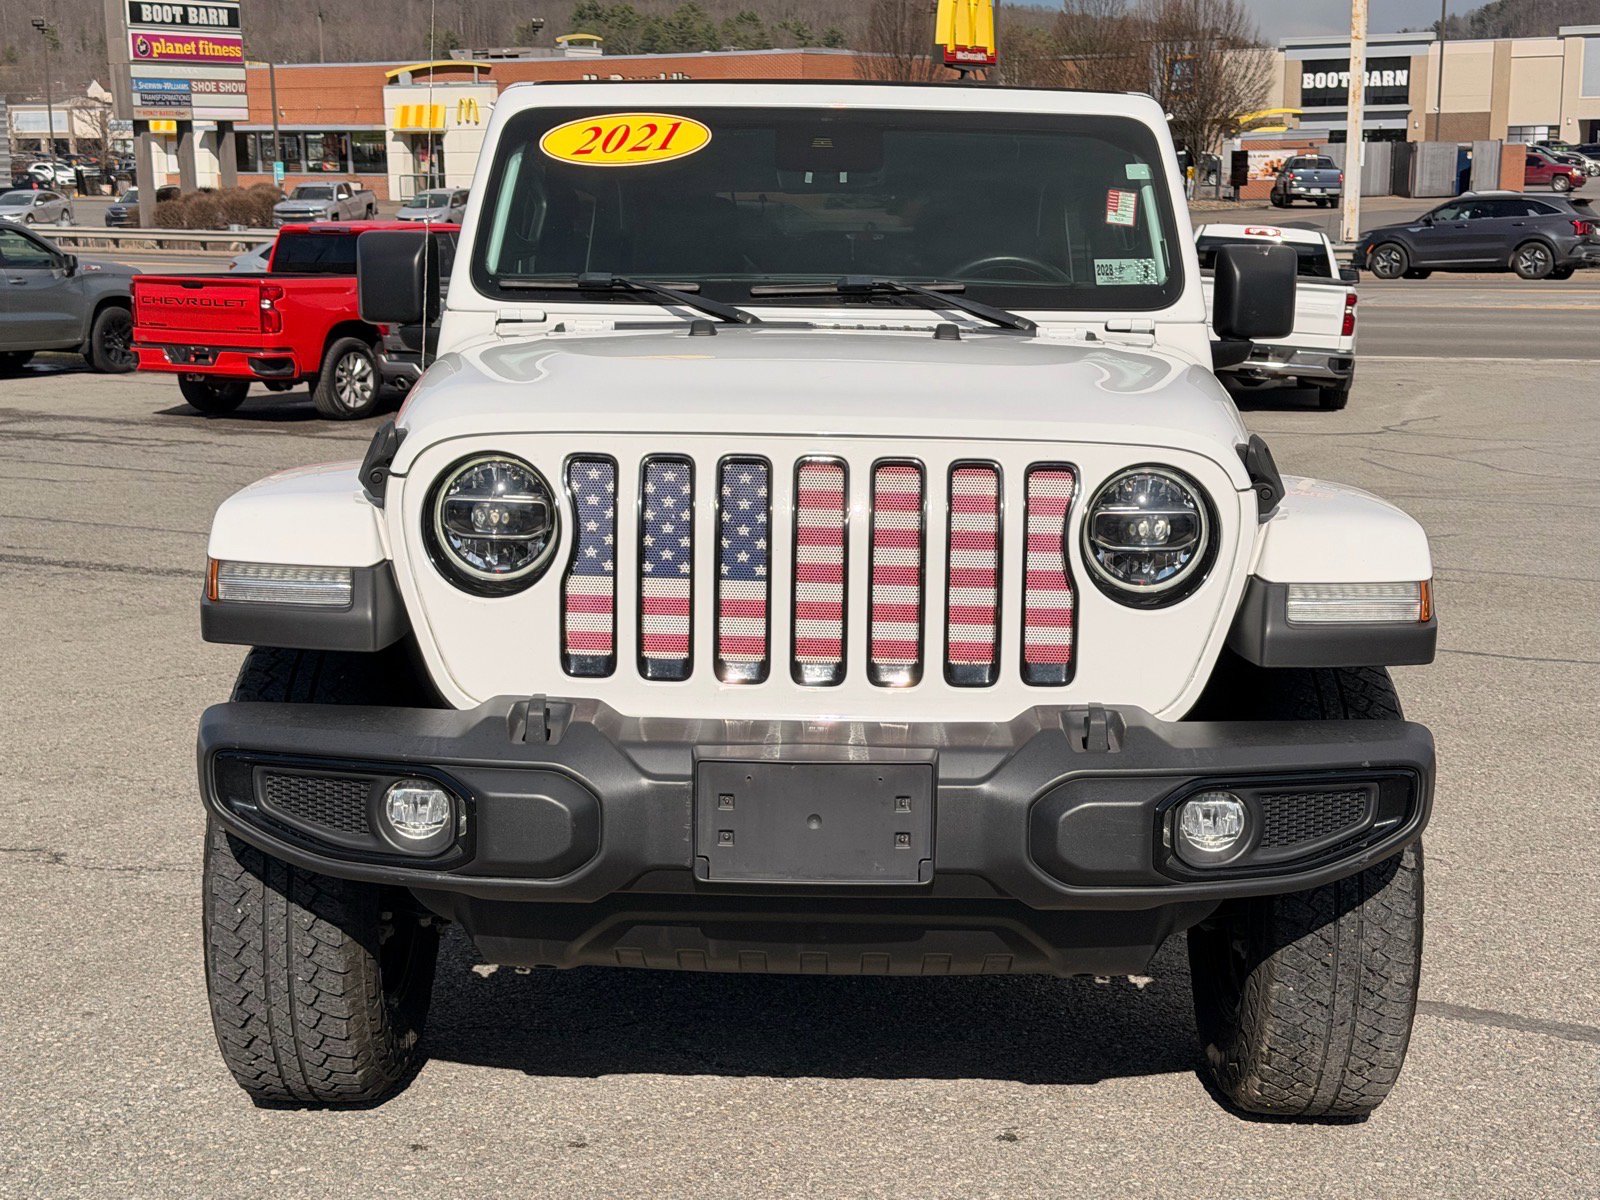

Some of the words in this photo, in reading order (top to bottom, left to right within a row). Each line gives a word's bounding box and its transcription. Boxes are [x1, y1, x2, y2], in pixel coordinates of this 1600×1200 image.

[141, 4, 184, 23] BOOT
[187, 9, 229, 26] BARN
[151, 38, 197, 57] planet
[199, 40, 242, 57] fitness
[191, 81, 217, 92] SHOE
[218, 81, 246, 93] SHOW
[1302, 71, 1350, 89] BOOT
[571, 121, 682, 155] 2021
[1143, 264, 1149, 278] 3
[141, 296, 247, 308] CHEVROLET
